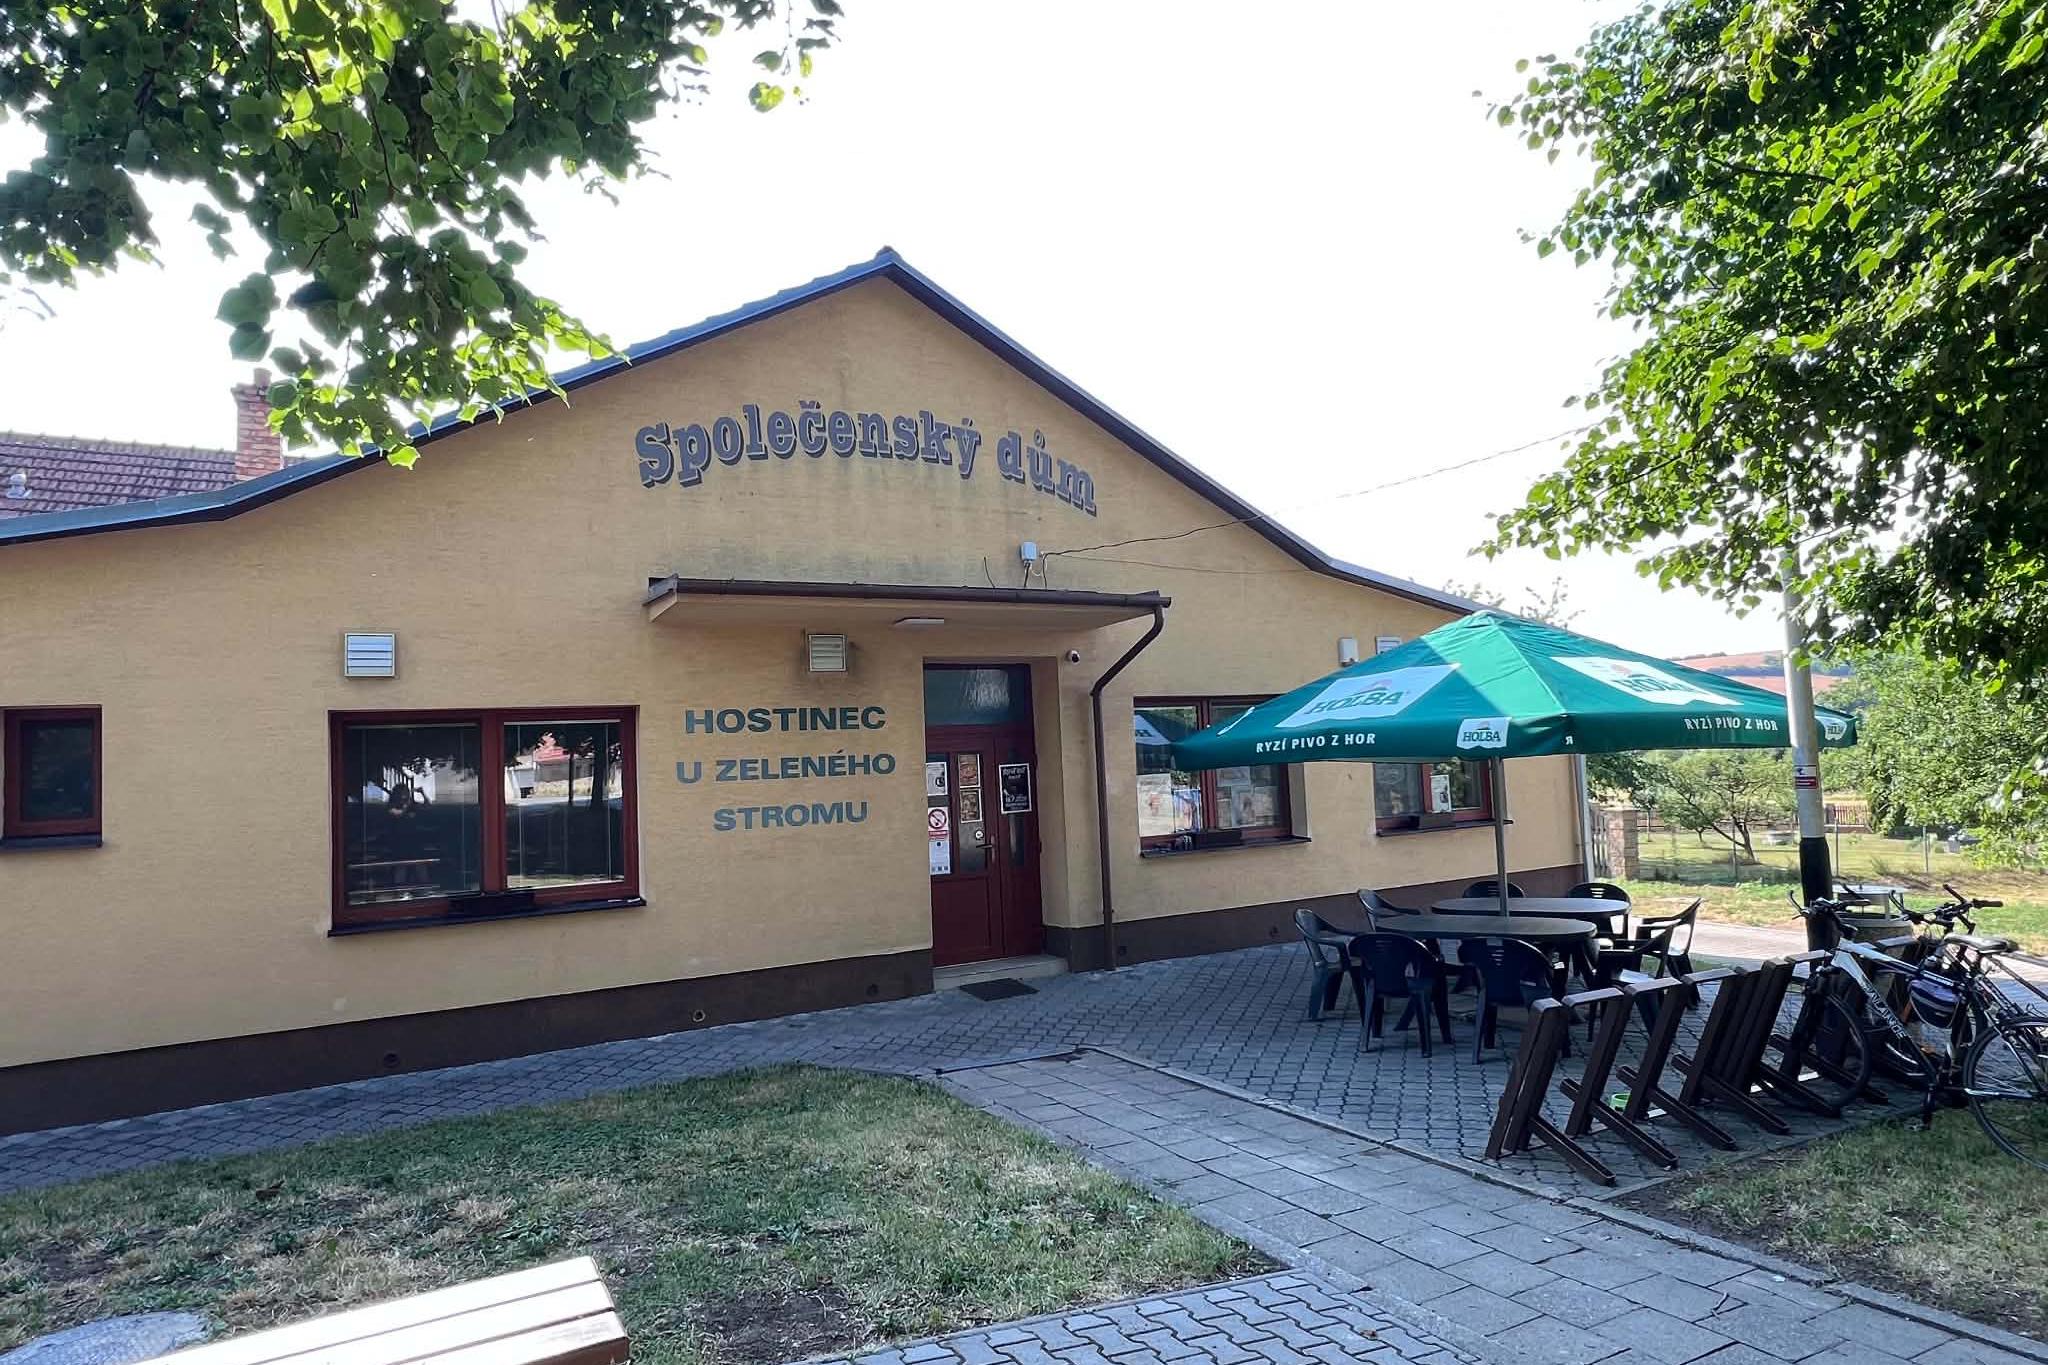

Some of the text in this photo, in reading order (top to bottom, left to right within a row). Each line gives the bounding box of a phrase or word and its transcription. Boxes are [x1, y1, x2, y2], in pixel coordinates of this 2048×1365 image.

[635, 400, 1097, 518] Společenský dům
[1303, 691, 1406, 714] HOLBA
[685, 706, 887, 734] HOSTINEC
[1683, 714, 1779, 731] RYZÍ PIVO Z HOR
[1255, 733, 1377, 753] RYZÍ PIVO Z HOR
[1462, 730, 1502, 742] HOLBA
[675, 761, 703, 784] U
[715, 749, 897, 783] ZELENÉHO
[713, 801, 869, 831] STROMU
